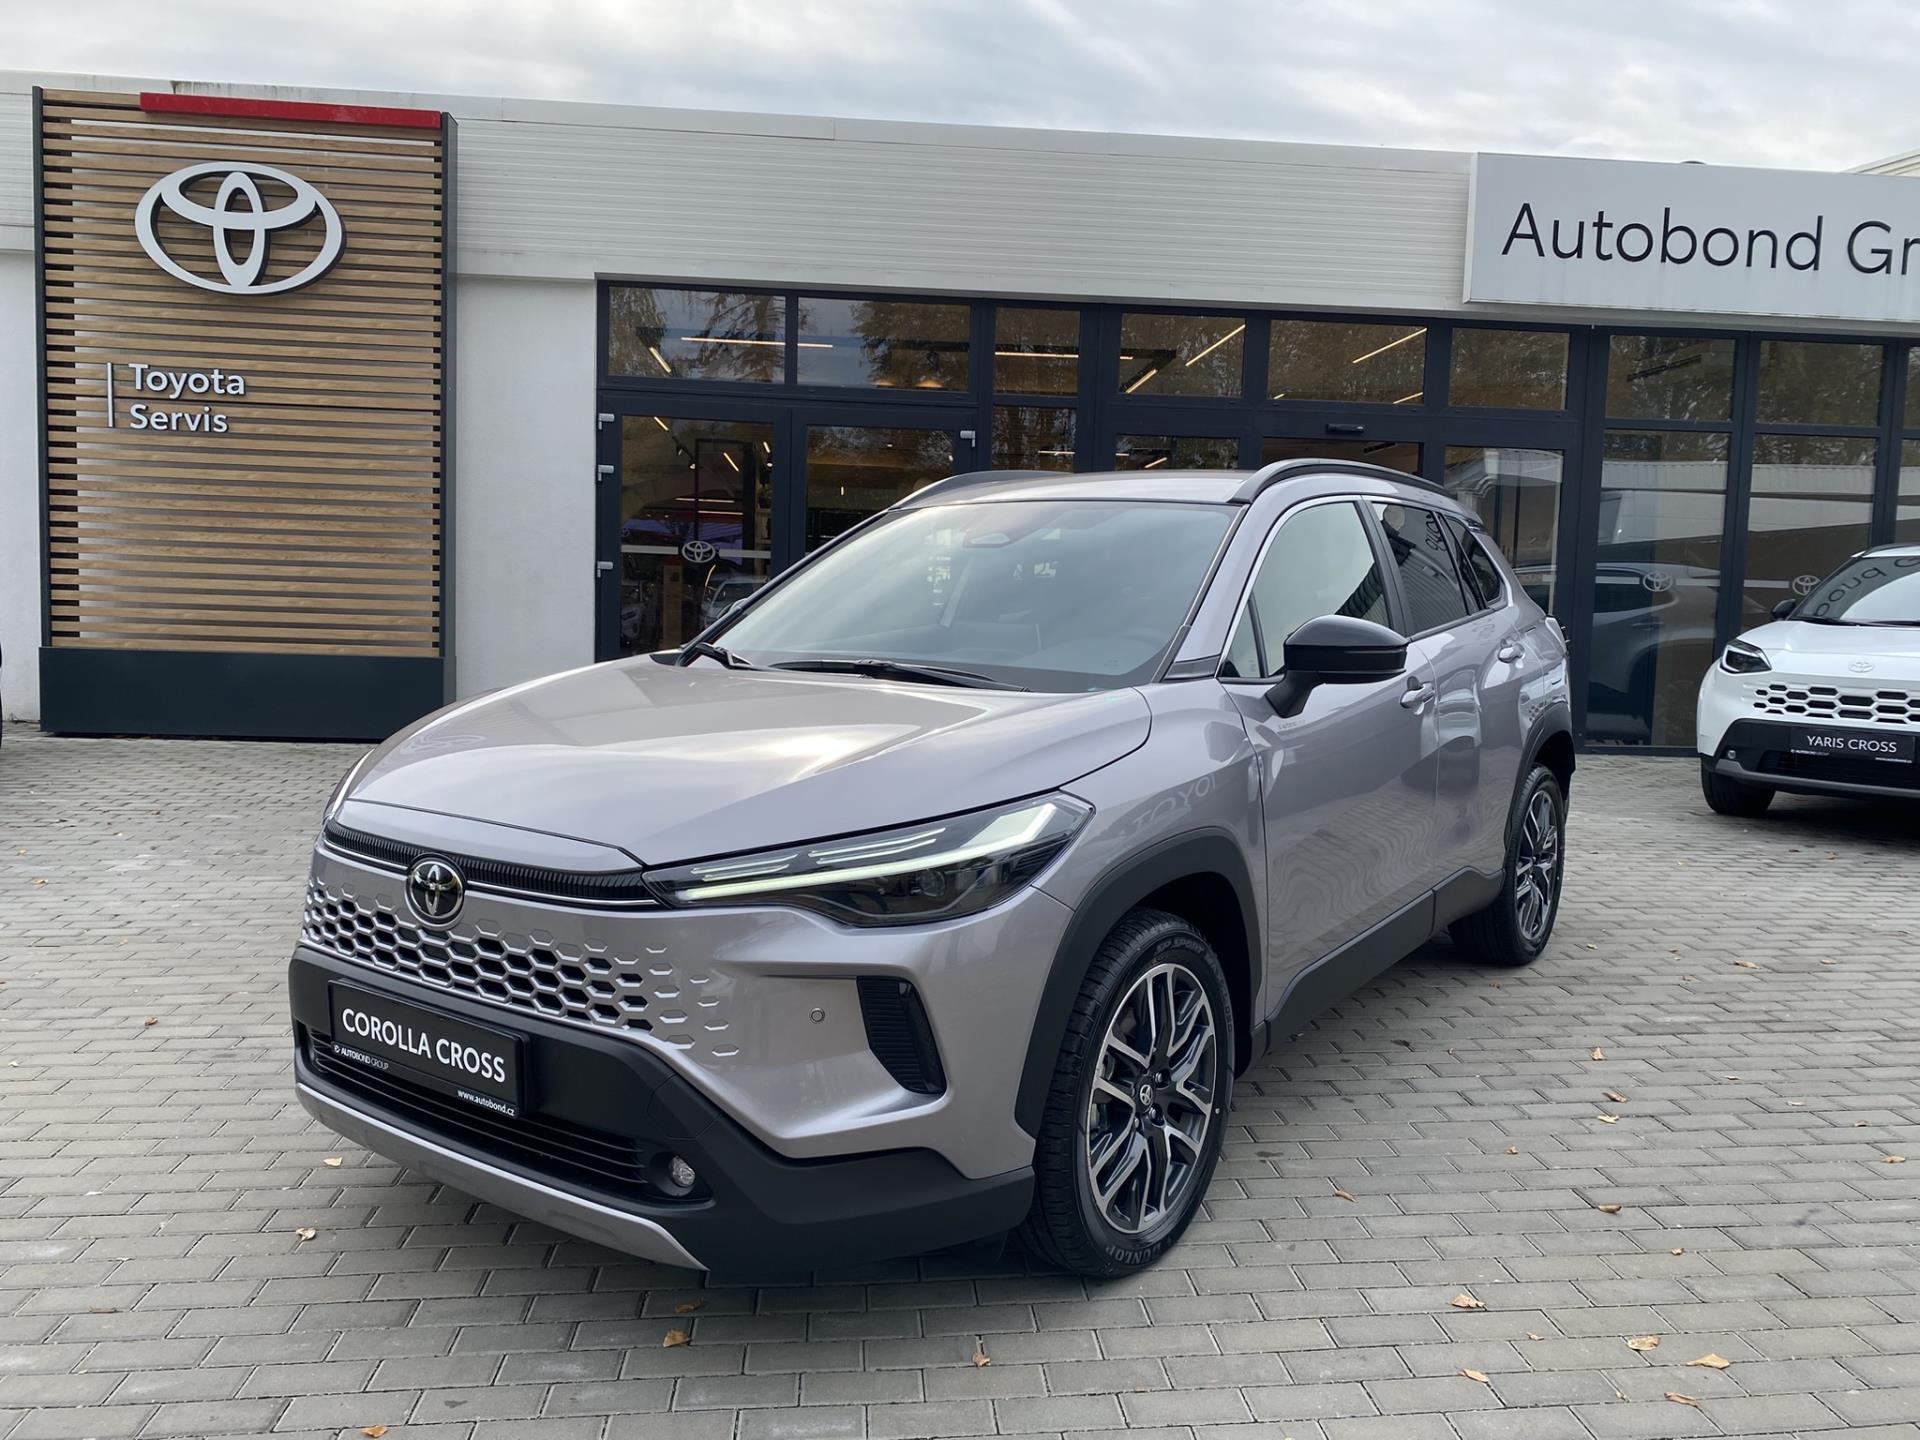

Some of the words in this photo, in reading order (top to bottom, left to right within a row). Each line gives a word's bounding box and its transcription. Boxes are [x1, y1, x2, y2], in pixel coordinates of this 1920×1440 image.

[1501, 203, 1824, 271] Autobond
[1847, 220, 1920, 275] Gr
[128, 363, 246, 400] Toyota
[129, 403, 229, 433] Servis
[1806, 735, 1845, 749] YARIS
[1847, 738, 1898, 753] CROSS
[340, 1047, 370, 1064] AUTOBOND
[371, 1057, 389, 1070] GROUP
[342, 1008, 432, 1059] COROLLA
[435, 1038, 506, 1083] CROSS
[457, 1089, 516, 1117] www.autobond.cz
